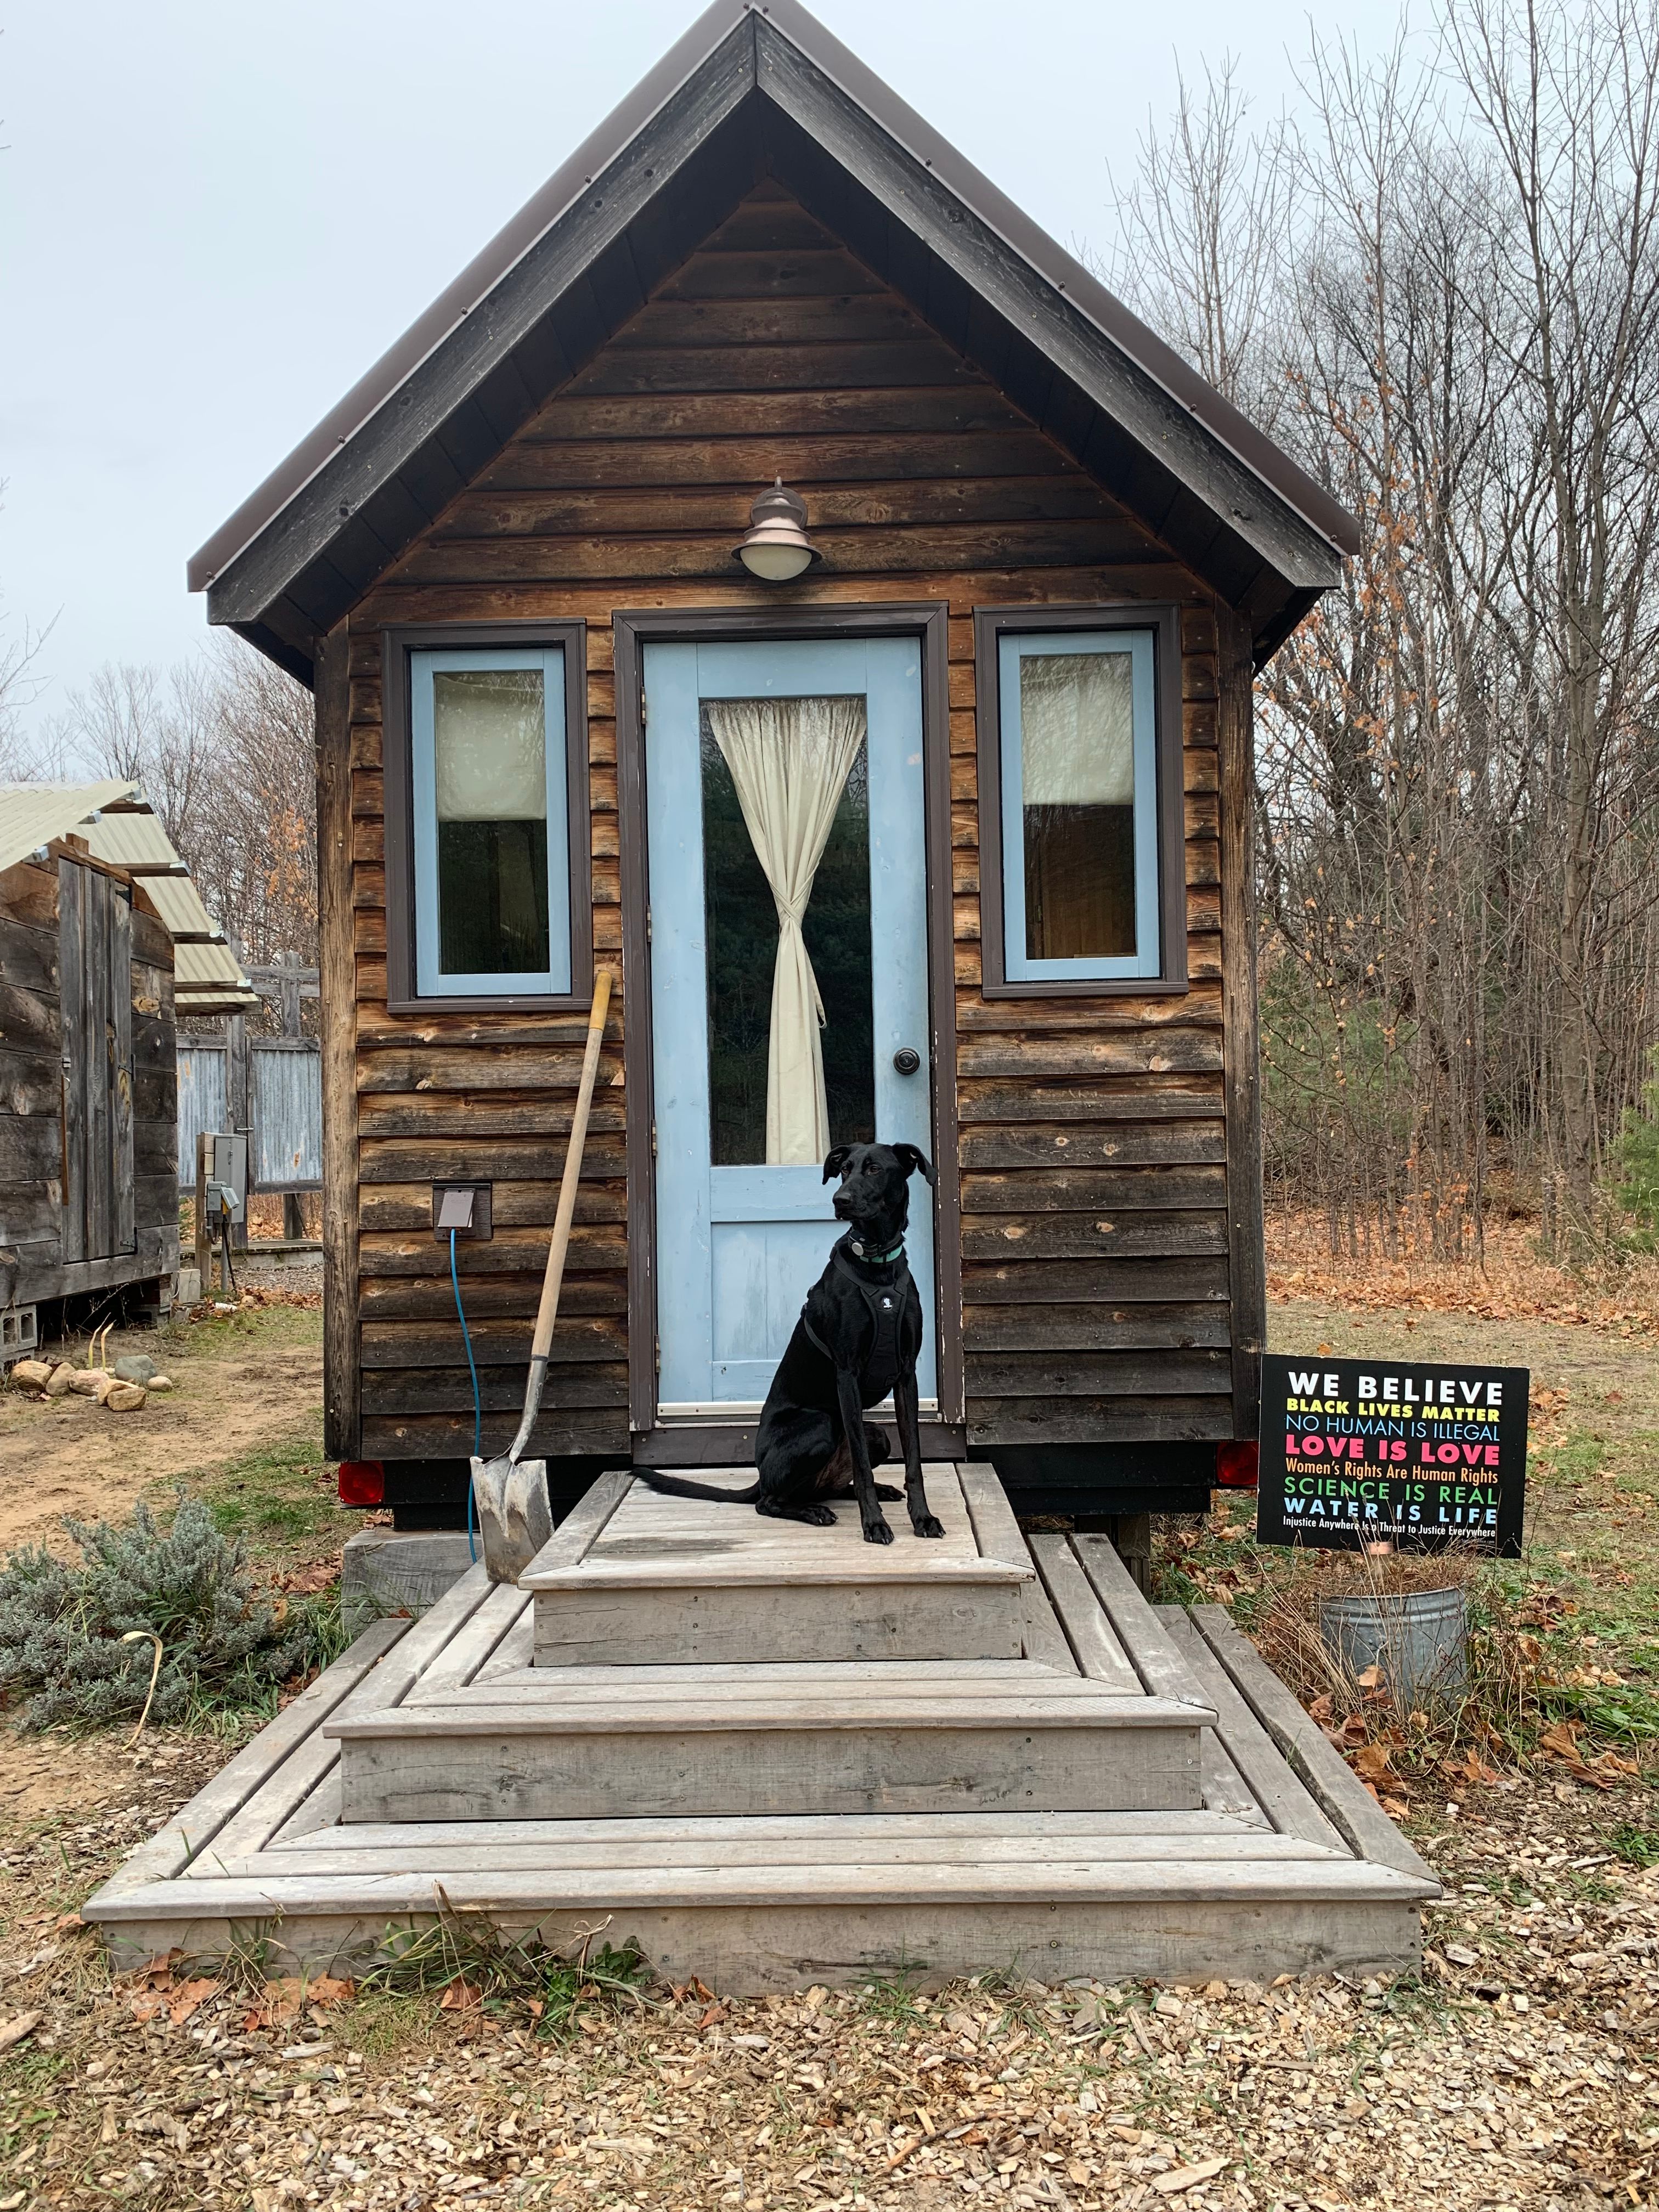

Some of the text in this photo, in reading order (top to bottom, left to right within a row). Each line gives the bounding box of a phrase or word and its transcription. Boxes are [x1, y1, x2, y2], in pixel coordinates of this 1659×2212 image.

[1288, 1372, 1503, 1405] WE BELIEVE
[1286, 1398, 1500, 1422] BLACK LIVES MATTER
[1286, 1414, 1500, 1441] NO HUMAN IS ILLEGAL
[1285, 1434, 1499, 1465] LOVE IS LOVE
[1285, 1457, 1498, 1486] Women's Rights Are Human Rights
[1284, 1476, 1497, 1505] SCIENCE IS REAL
[1284, 1497, 1497, 1524] WATER IS LIFE
[1283, 1515, 1316, 1528] Injustice
[1319, 1517, 1359, 1531] Anywhere
[1362, 1521, 1369, 1530] Is
[1379, 1522, 1405, 1533] Threat
[1408, 1525, 1416, 1534] to
[1418, 1524, 1446, 1535] Justice
[1448, 1525, 1496, 1538] Everywhere
